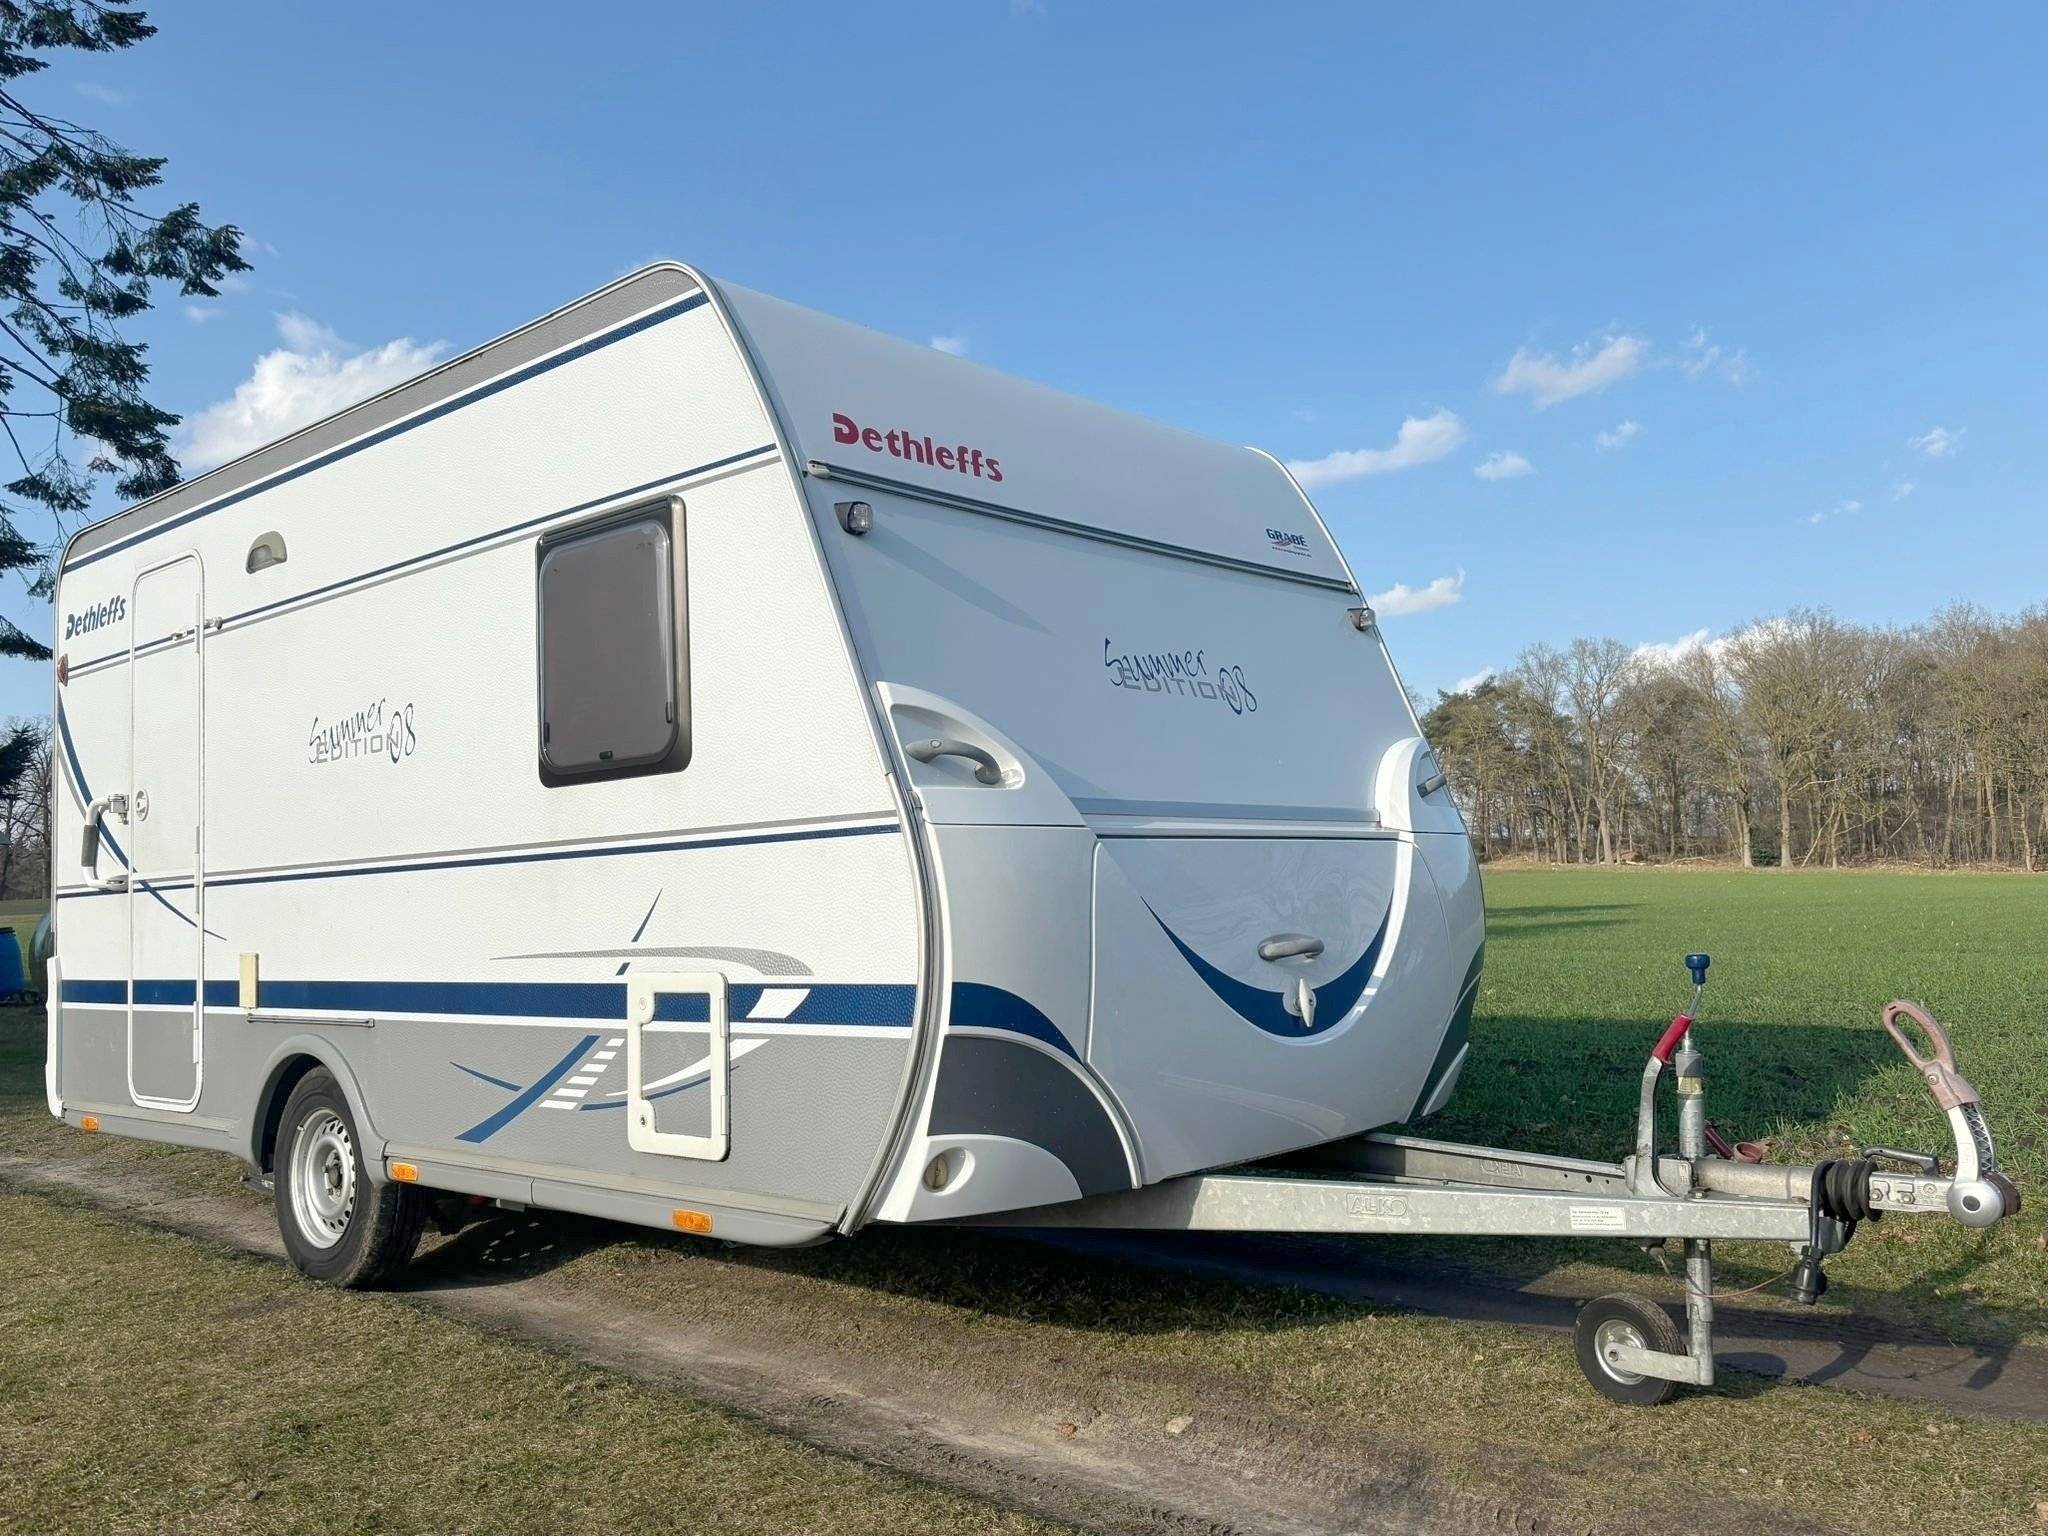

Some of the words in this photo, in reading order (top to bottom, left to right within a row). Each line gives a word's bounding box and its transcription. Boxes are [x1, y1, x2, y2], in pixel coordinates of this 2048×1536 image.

[832, 413, 1003, 482] Dethleffs
[65, 595, 126, 640] Dethleffs
[1105, 638, 1207, 686] Summer
[1117, 666, 1238, 702] EDITION
[1219, 665, 1257, 715] 08
[309, 697, 386, 763] Summer
[316, 730, 399, 763] EDITION
[390, 703, 416, 763] 08
